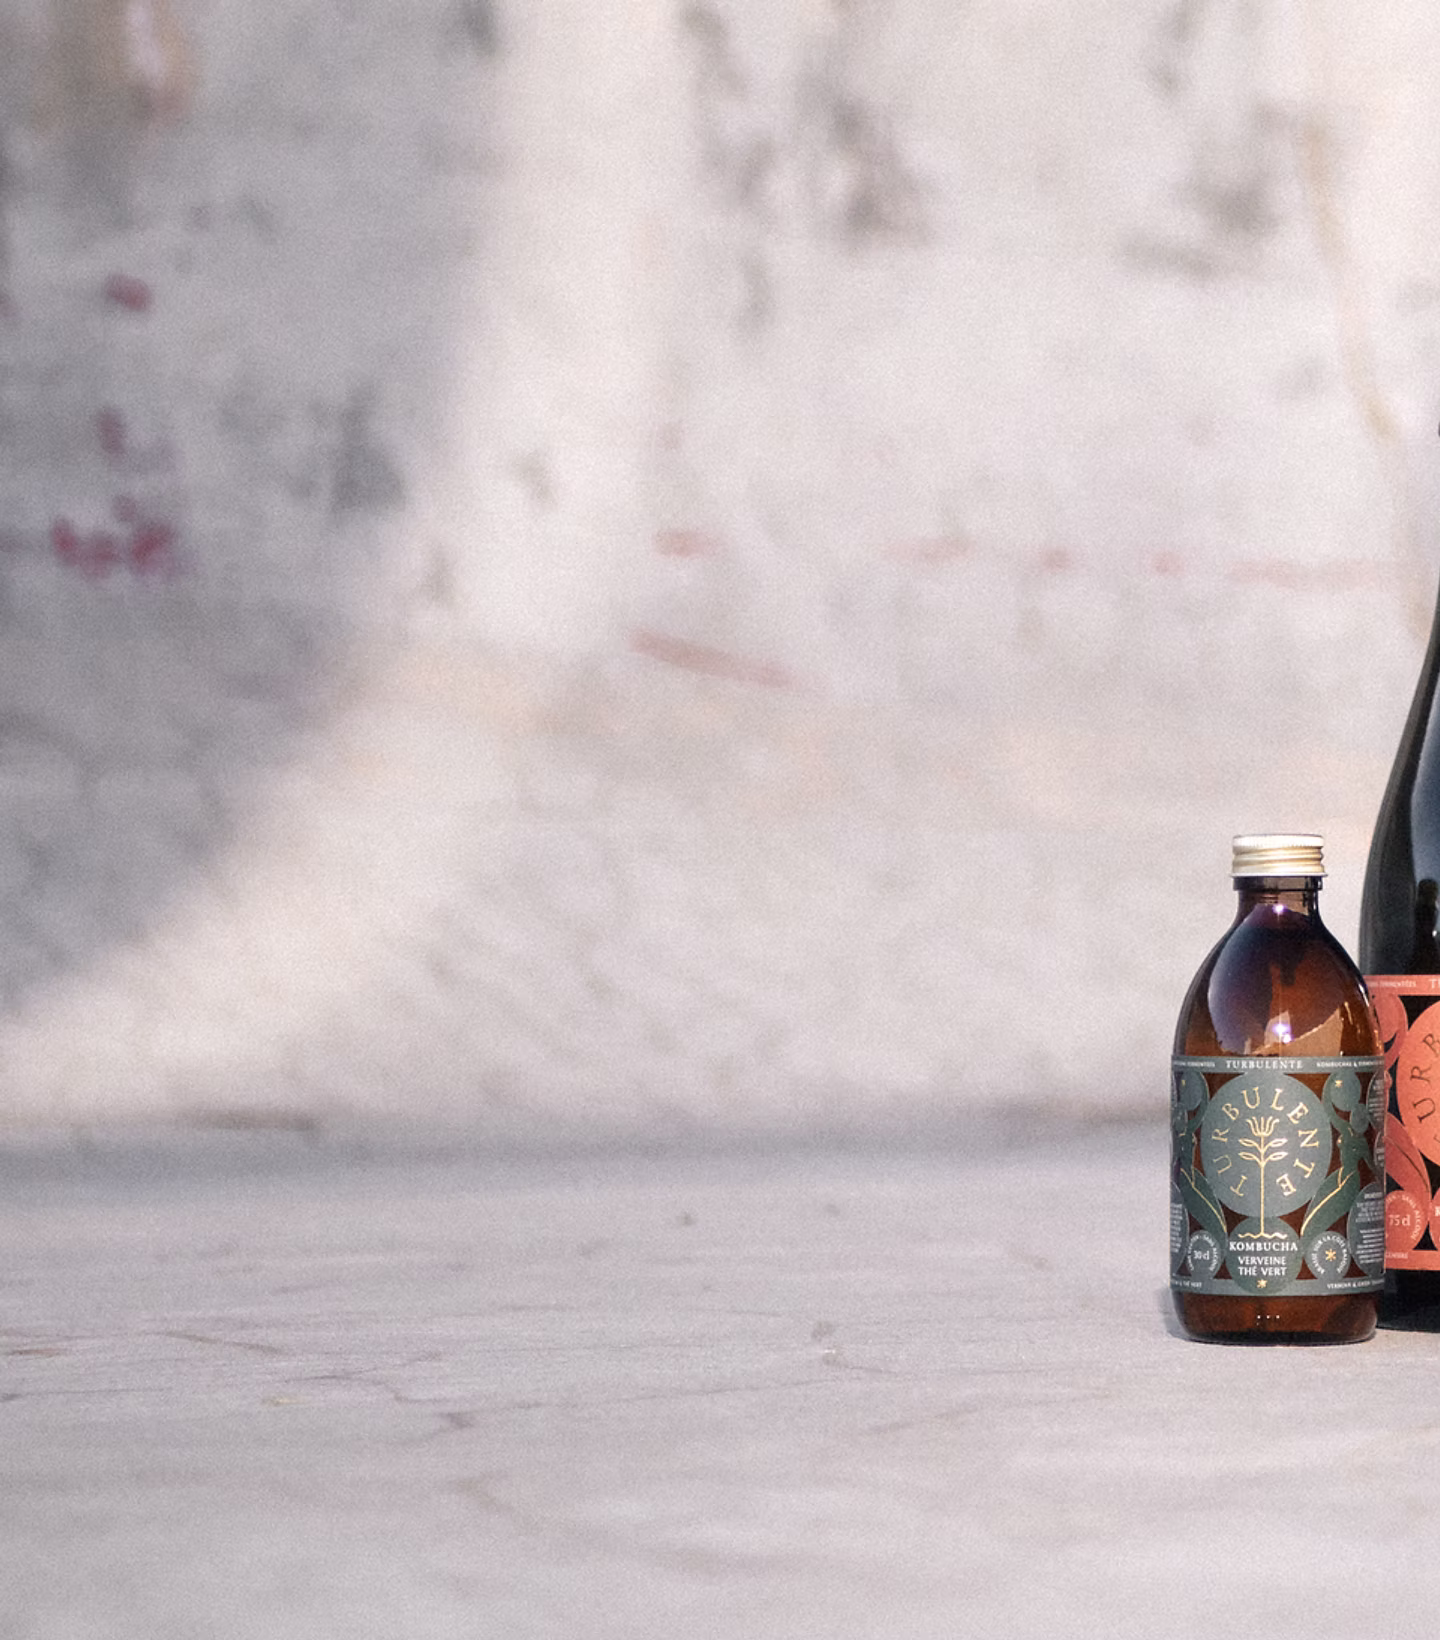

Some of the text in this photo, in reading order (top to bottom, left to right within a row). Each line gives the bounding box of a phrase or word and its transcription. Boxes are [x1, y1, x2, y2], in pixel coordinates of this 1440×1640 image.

[1226, 1060, 1303, 1069] TURBULENTE
[1211, 1087, 1319, 1197] TURBULENTE
[1388, 1214, 1400, 1226] 75
[1229, 1241, 1298, 1252] KOMBUCHA
[1238, 1256, 1287, 1265] VERVEINE
[1238, 1265, 1287, 1276] THÉ VERT
